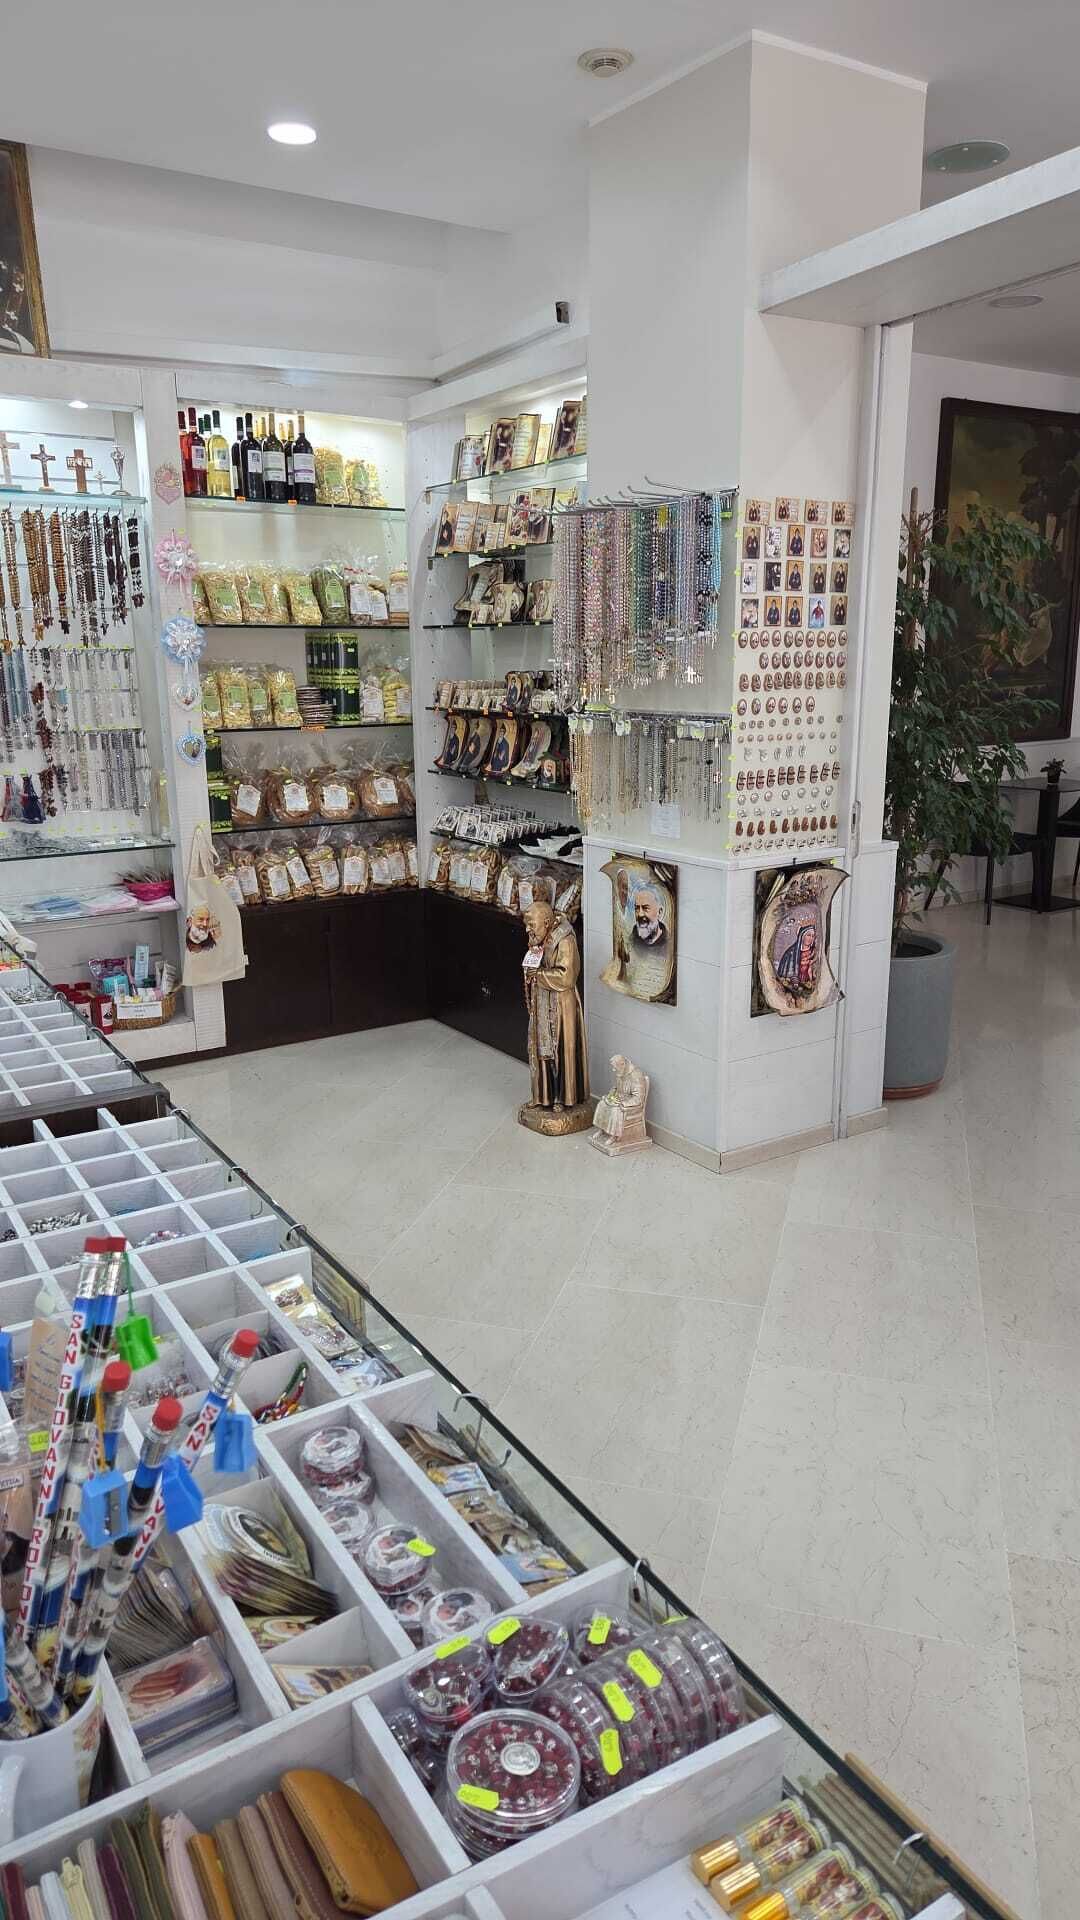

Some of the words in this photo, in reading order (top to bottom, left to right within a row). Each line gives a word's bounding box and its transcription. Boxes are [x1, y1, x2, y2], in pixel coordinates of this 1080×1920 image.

[63, 1313, 84, 1365] SAN
[38, 1373, 73, 1518] GIOVANNI
[186, 1404, 220, 1451] SAN
